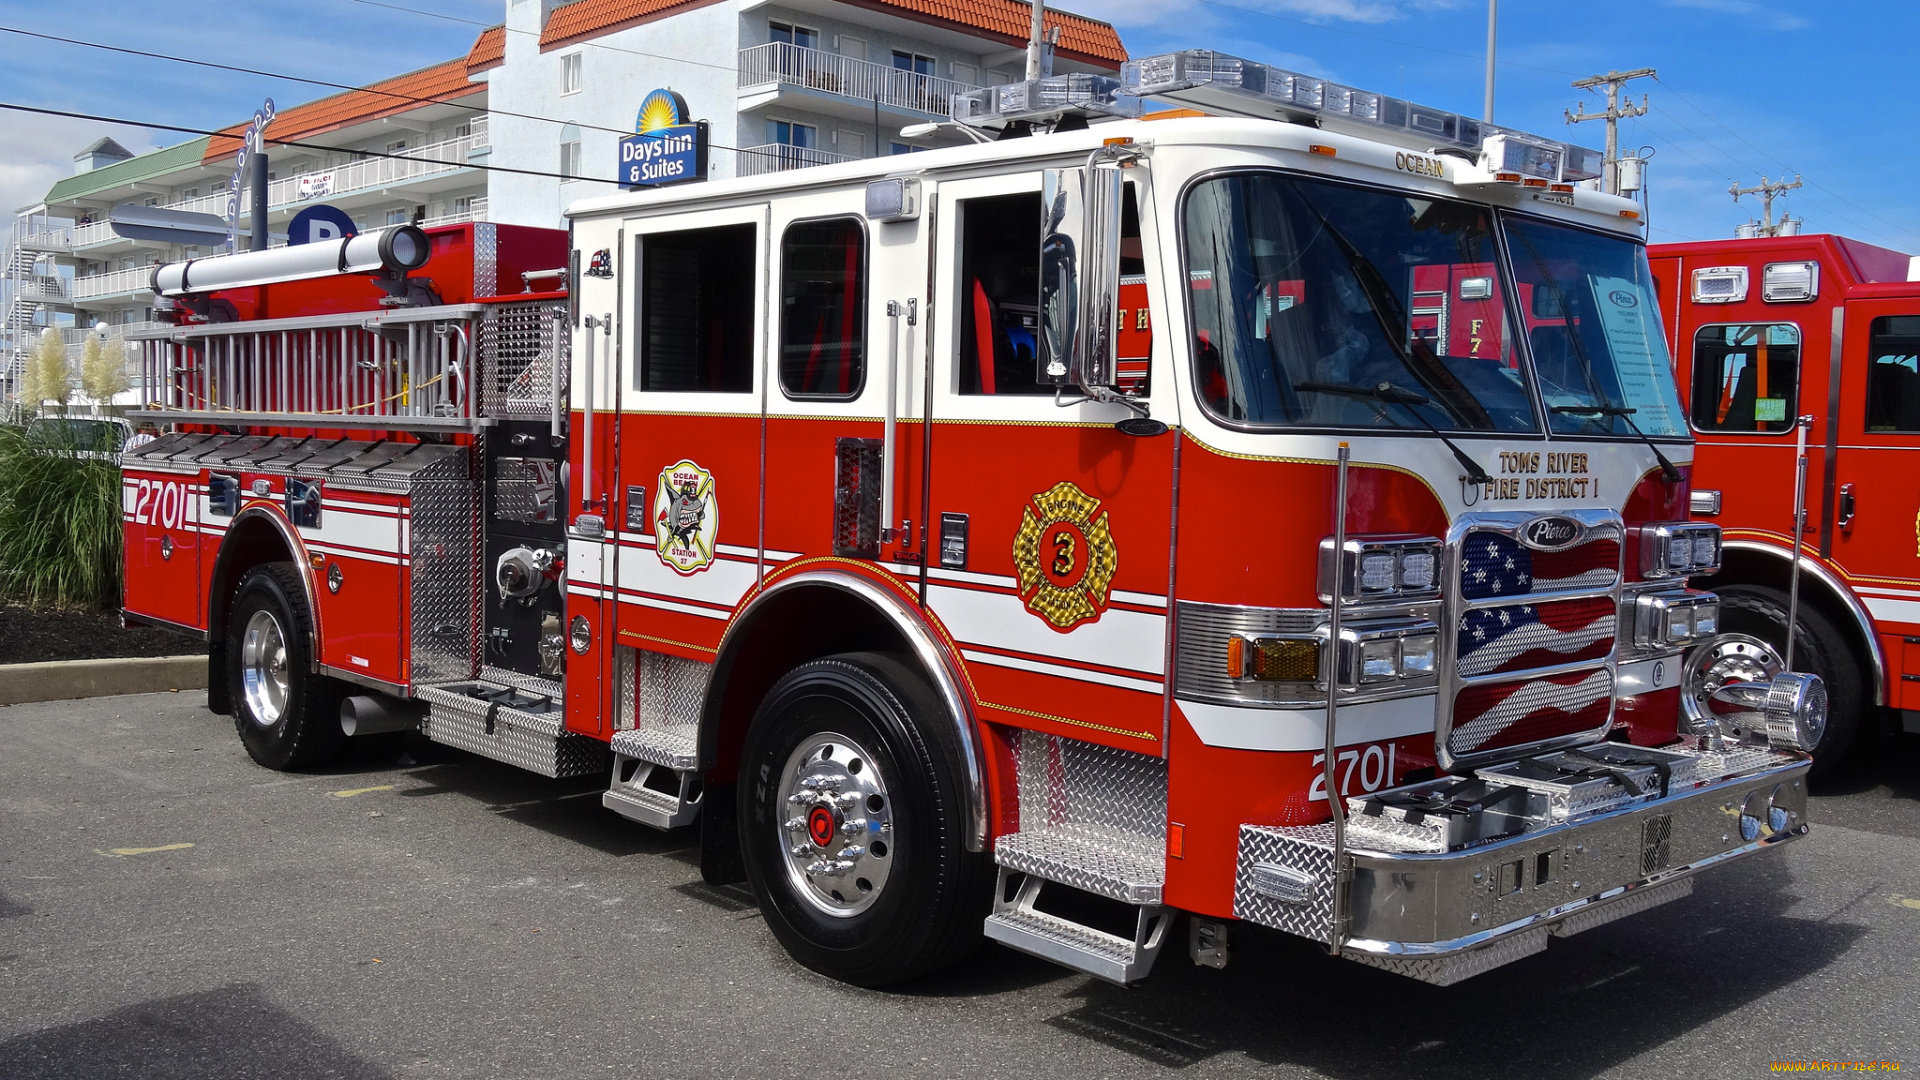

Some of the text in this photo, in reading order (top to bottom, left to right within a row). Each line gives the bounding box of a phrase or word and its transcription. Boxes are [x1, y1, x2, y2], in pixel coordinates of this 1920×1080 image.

[623, 134, 692, 162] Days Inn
[630, 158, 684, 182] & Suites
[1395, 151, 1444, 178] OCEAN
[1499, 451, 1589, 474] TOMS RIVER
[673, 472, 699, 480] OCEAN
[1484, 478, 1520, 500] FIRE
[1525, 478, 1589, 499] DISTRICT
[135, 478, 186, 530] 2701
[1047, 499, 1085, 516] ENGINE
[1533, 520, 1571, 543] Pierce
[671, 548, 697, 559] STATION
[1052, 532, 1076, 578] 3
[1042, 593, 1071, 610] STATION
[1308, 743, 1396, 802] 2701
